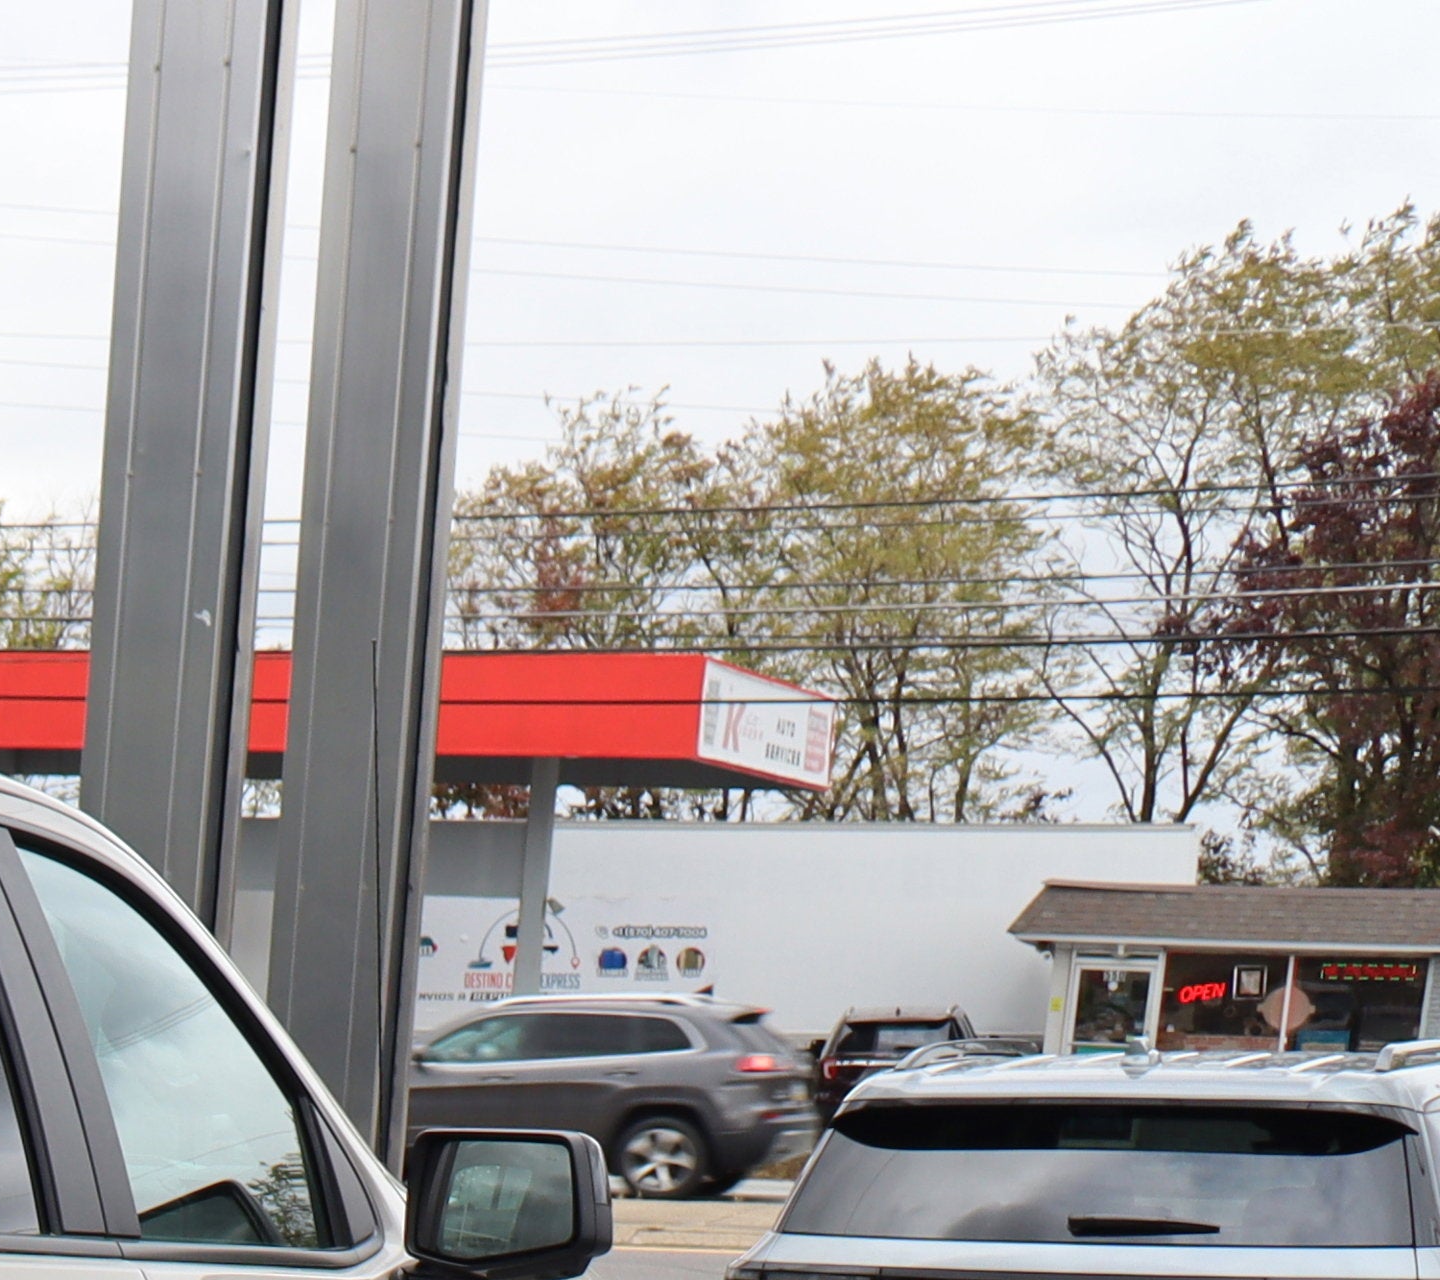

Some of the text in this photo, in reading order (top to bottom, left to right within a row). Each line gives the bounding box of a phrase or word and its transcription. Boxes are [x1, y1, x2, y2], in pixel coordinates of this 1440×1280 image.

[464, 972, 503, 990] DESTINO
[540, 972, 582, 990] EXPRESS
[418, 993, 455, 1002] NVIOS
[1177, 982, 1226, 1004] OPEN
